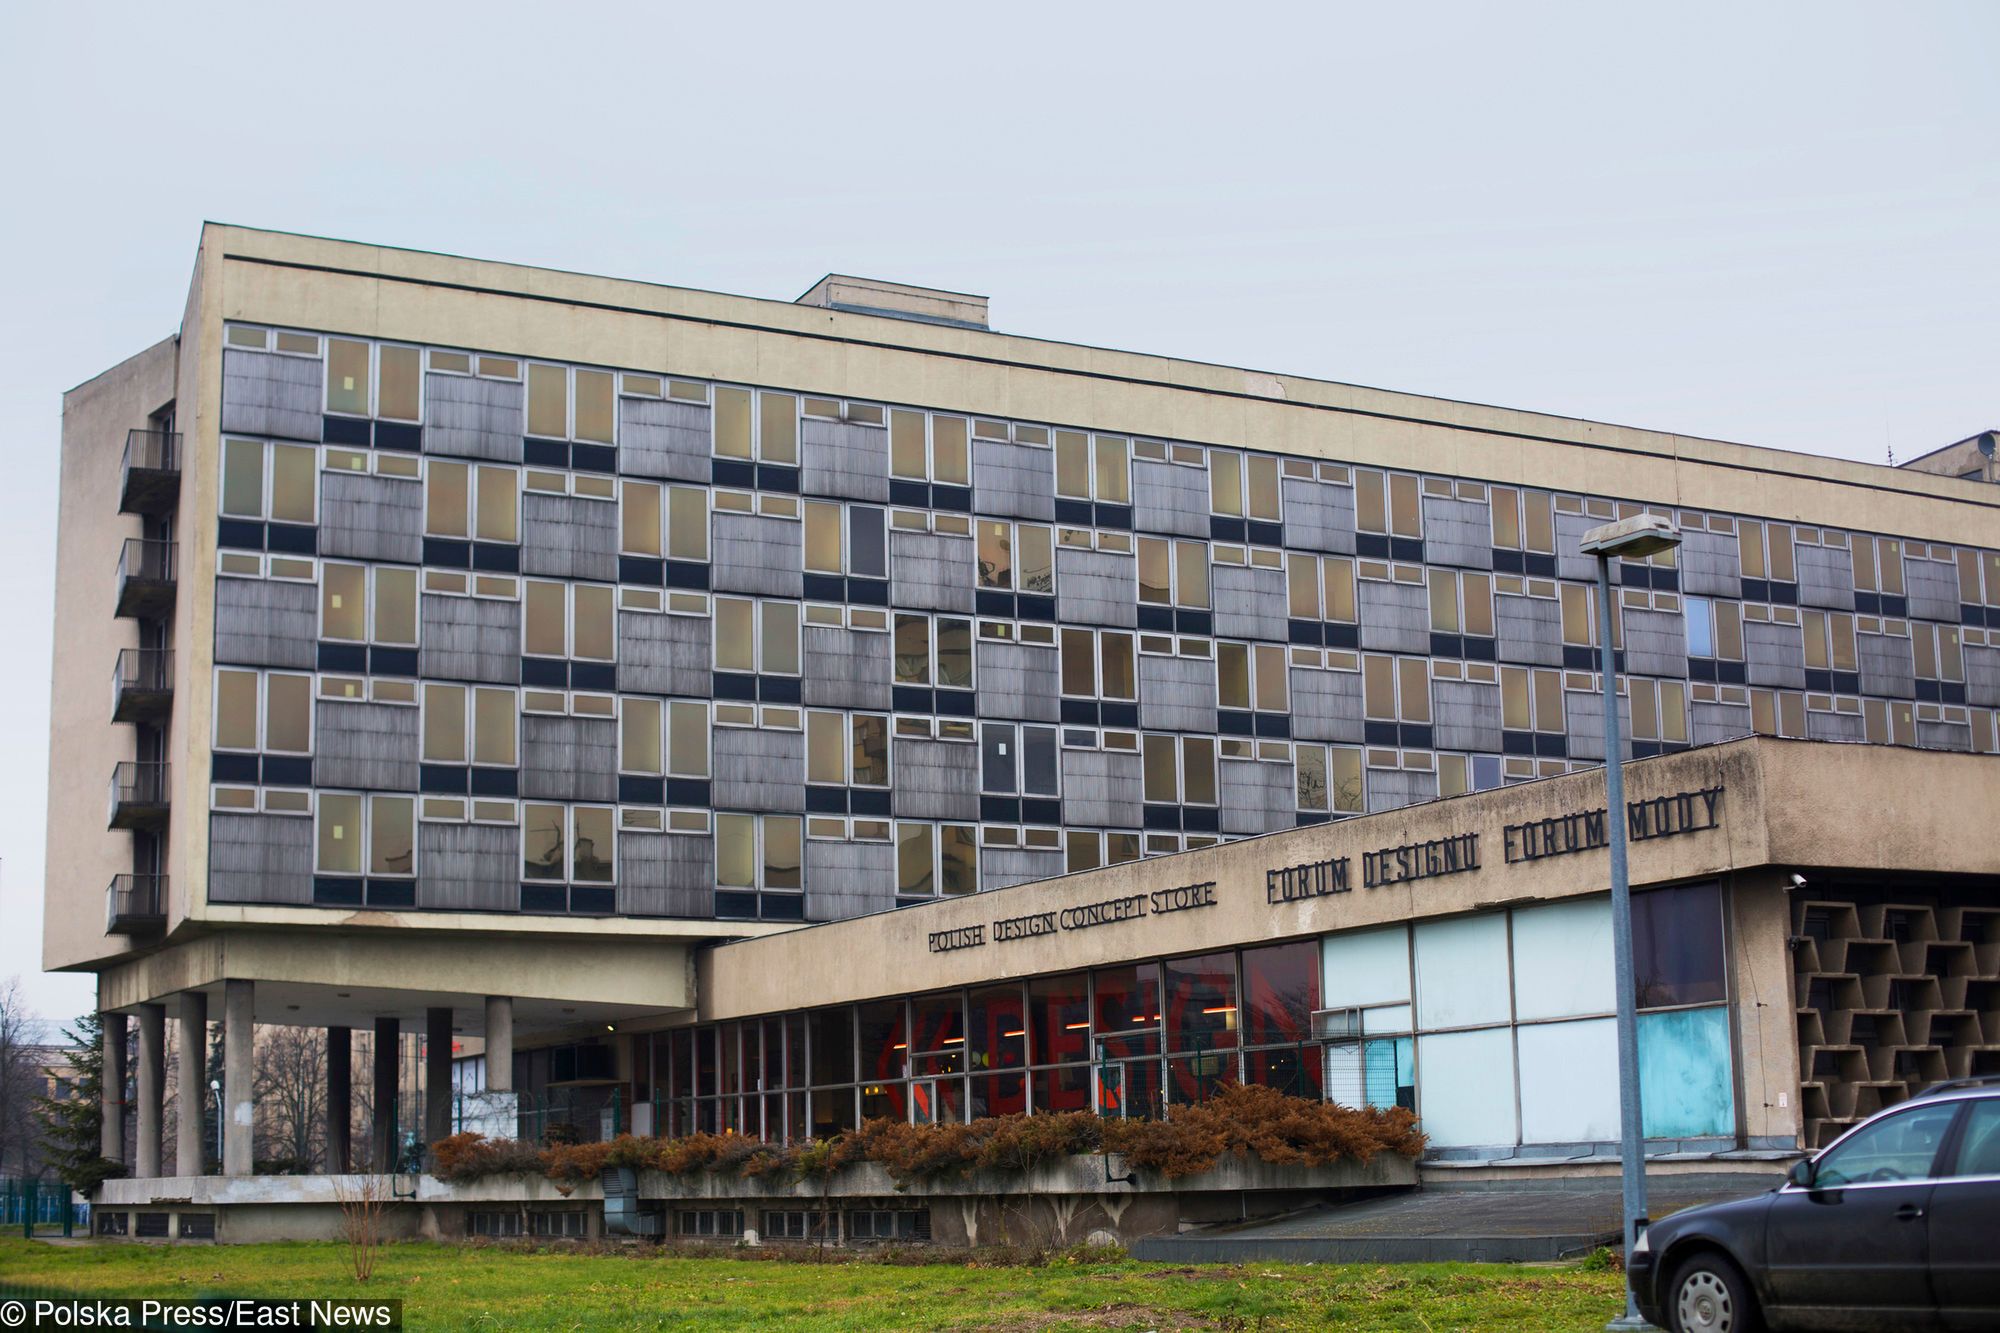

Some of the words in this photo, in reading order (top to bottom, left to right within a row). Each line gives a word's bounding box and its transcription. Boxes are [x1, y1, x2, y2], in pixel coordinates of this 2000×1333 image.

[1503, 809, 1609, 864] FORUM
[1627, 785, 1724, 842] MODY
[1266, 857, 1352, 904] FORUM
[1362, 833, 1482, 888] DESIGNU
[928, 925, 986, 952] POLISH
[993, 911, 1058, 941] DESIGN
[1059, 894, 1148, 931] CONCEPT
[1150, 882, 1218, 914] STORE
